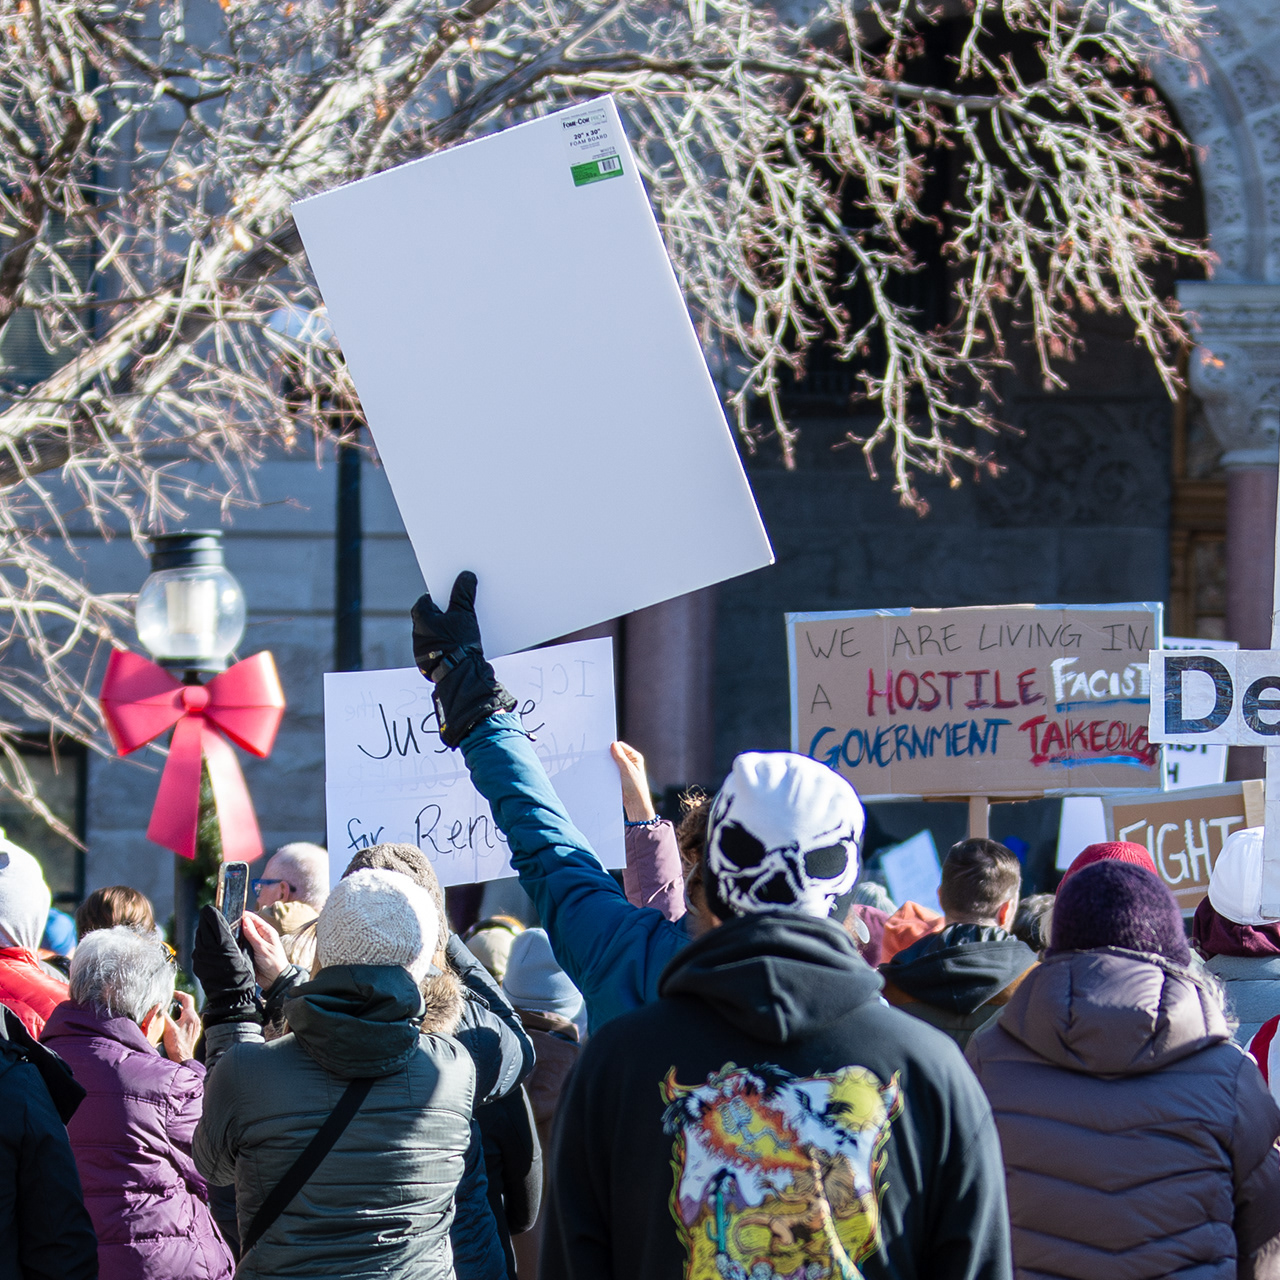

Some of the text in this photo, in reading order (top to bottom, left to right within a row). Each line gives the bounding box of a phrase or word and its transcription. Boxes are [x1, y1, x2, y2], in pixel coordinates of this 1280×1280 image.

[569, 139, 586, 147] FOAM
[587, 133, 608, 142] BOARD
[806, 623, 1149, 658] WE ARE LIVING IN
[811, 683, 832, 714] A
[808, 718, 1013, 769] GOVERNMENT
